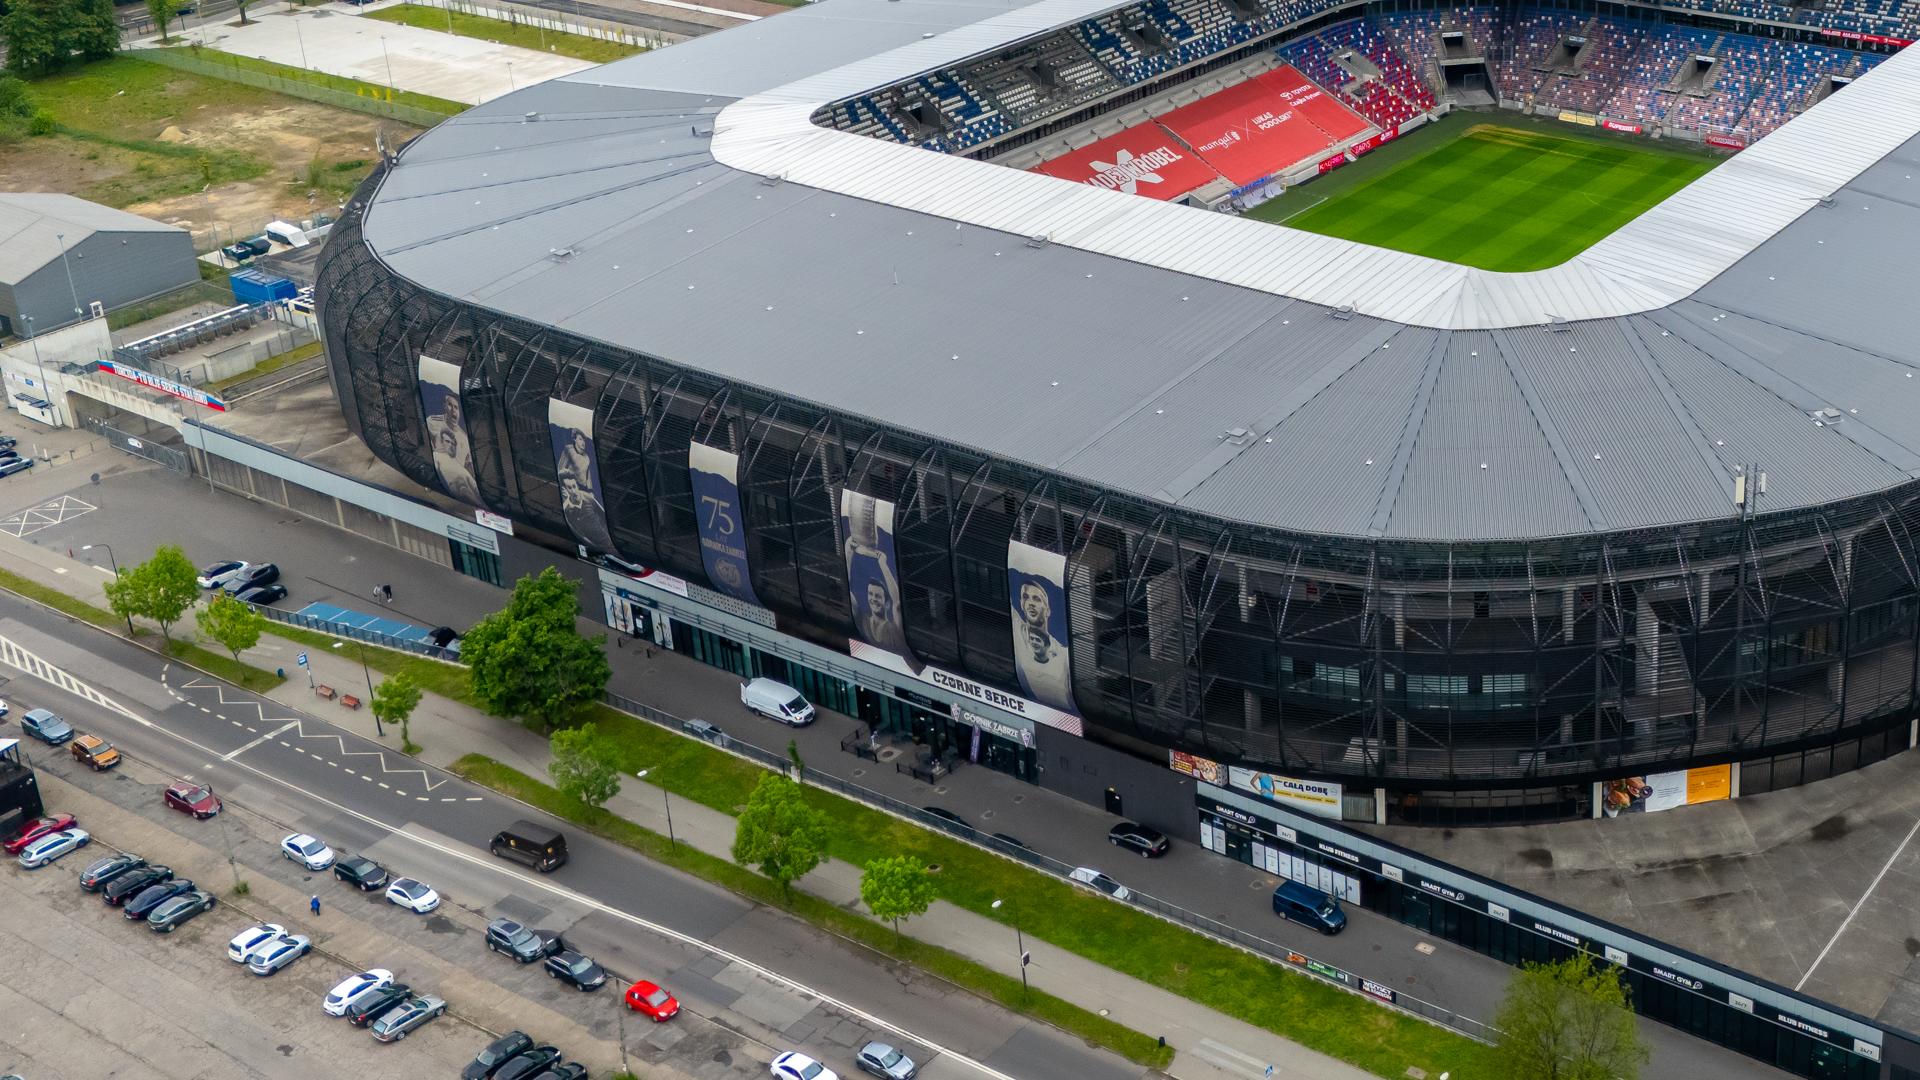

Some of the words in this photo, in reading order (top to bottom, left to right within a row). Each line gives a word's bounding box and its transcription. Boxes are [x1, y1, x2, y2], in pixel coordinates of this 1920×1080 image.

[1291, 84, 1312, 95] TOYOTA
[1250, 112, 1273, 125] LUKAS
[702, 495, 734, 535] 75
[984, 689, 1026, 713] SERCE
[963, 712, 992, 728] GÓRNIK
[993, 721, 1020, 738] ZABRZE
[1305, 785, 1328, 796] DOBĘ
[1216, 805, 1234, 817] SMART
[1334, 848, 1359, 863] FITNESS
[1420, 880, 1441, 892] SMART
[1441, 888, 1455, 898] GYM
[1534, 922, 1552, 934] KLUB
[1552, 929, 1580, 944] FITNESS
[1653, 967, 1676, 980] SMART
[1676, 976, 1692, 988] GYM
[1778, 1014, 1797, 1027] KLUB
[1797, 1021, 1829, 1038] FITNESS
